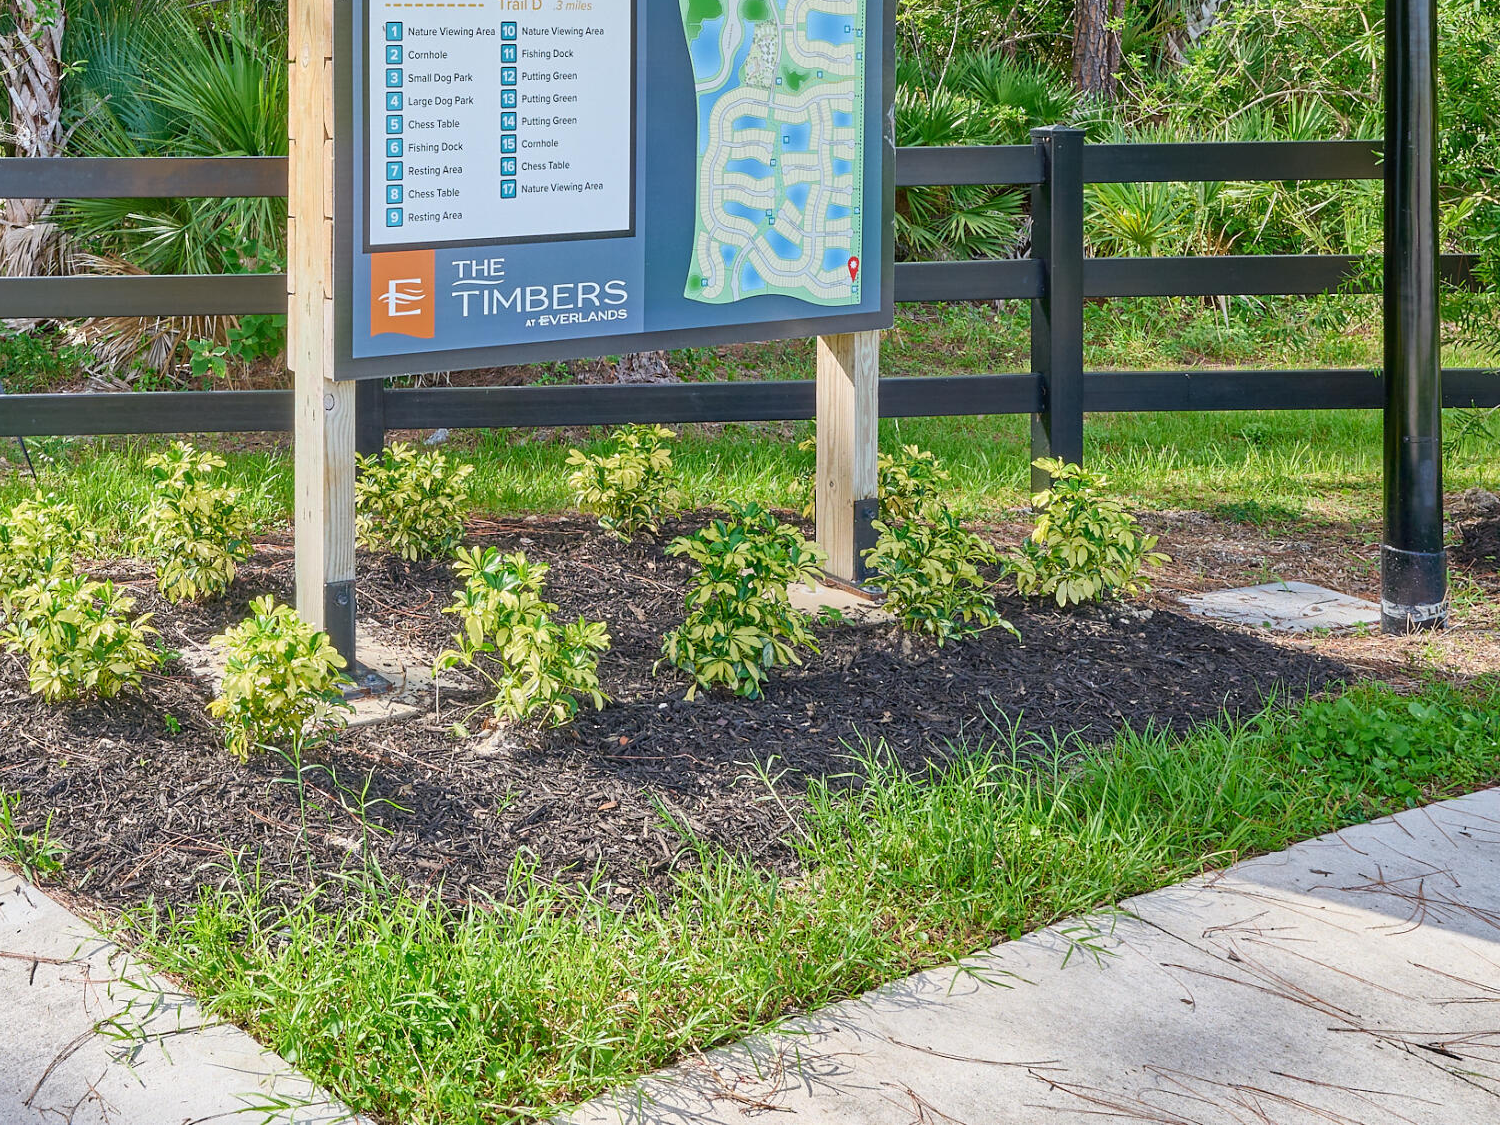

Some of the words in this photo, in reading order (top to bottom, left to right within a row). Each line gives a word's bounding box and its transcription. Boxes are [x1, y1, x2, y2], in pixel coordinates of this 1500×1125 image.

[565, 0, 592, 11] miles
[391, 26, 397, 36] 1
[408, 28, 437, 36] Nature
[440, 27, 474, 37] Viewing
[476, 27, 495, 35] Area
[503, 26, 515, 36] 10
[522, 27, 549, 35] Nature
[551, 27, 583, 37] Viewing
[585, 27, 604, 35] Area
[390, 49, 398, 60] 2
[408, 50, 448, 59] Cornhole
[504, 49, 514, 59] 11
[522, 49, 551, 59] Fishing
[553, 49, 573, 58] Dock
[390, 73, 398, 83] 3
[408, 74, 432, 83] Small
[434, 74, 451, 84] Dog
[454, 73, 472, 82] Park
[503, 71, 515, 81] 12
[522, 72, 551, 82] Putting
[553, 72, 577, 81] Green
[390, 96, 399, 107] 4
[408, 97, 432, 107] Large
[435, 97, 453, 107] Dog
[455, 96, 473, 105] Park
[503, 93, 514, 104] 13
[522, 95, 551, 105] Putting
[553, 94, 577, 103] Green
[391, 119, 398, 130] 5
[408, 120, 435, 129] Chess
[437, 119, 460, 128] Table
[503, 116, 515, 126] 14
[522, 117, 551, 127] Putting
[553, 116, 577, 125] Green
[391, 142, 399, 153] 6
[409, 143, 439, 153] Fishing
[441, 142, 463, 151] Dock
[503, 139, 514, 149] 15
[521, 139, 558, 148] Cornhole
[391, 166, 398, 176] 7
[408, 166, 440, 176] Resting
[442, 166, 462, 174] Area
[502, 161, 514, 172] 16
[521, 162, 546, 171] Chess
[548, 161, 570, 170] Table
[503, 184, 514, 194] 17
[521, 184, 549, 193] Nature
[551, 183, 583, 193] Viewing
[585, 182, 603, 191] Area
[390, 189, 399, 200] 8
[408, 189, 435, 199] Chess
[437, 188, 460, 197] Table
[390, 212, 399, 223] 9
[408, 212, 440, 223] Resting
[442, 211, 462, 220] Area
[452, 258, 504, 278] THE
[452, 280, 628, 316] TIMBERS
[525, 319, 535, 327] AT
[539, 309, 628, 326] EVERLANDS
